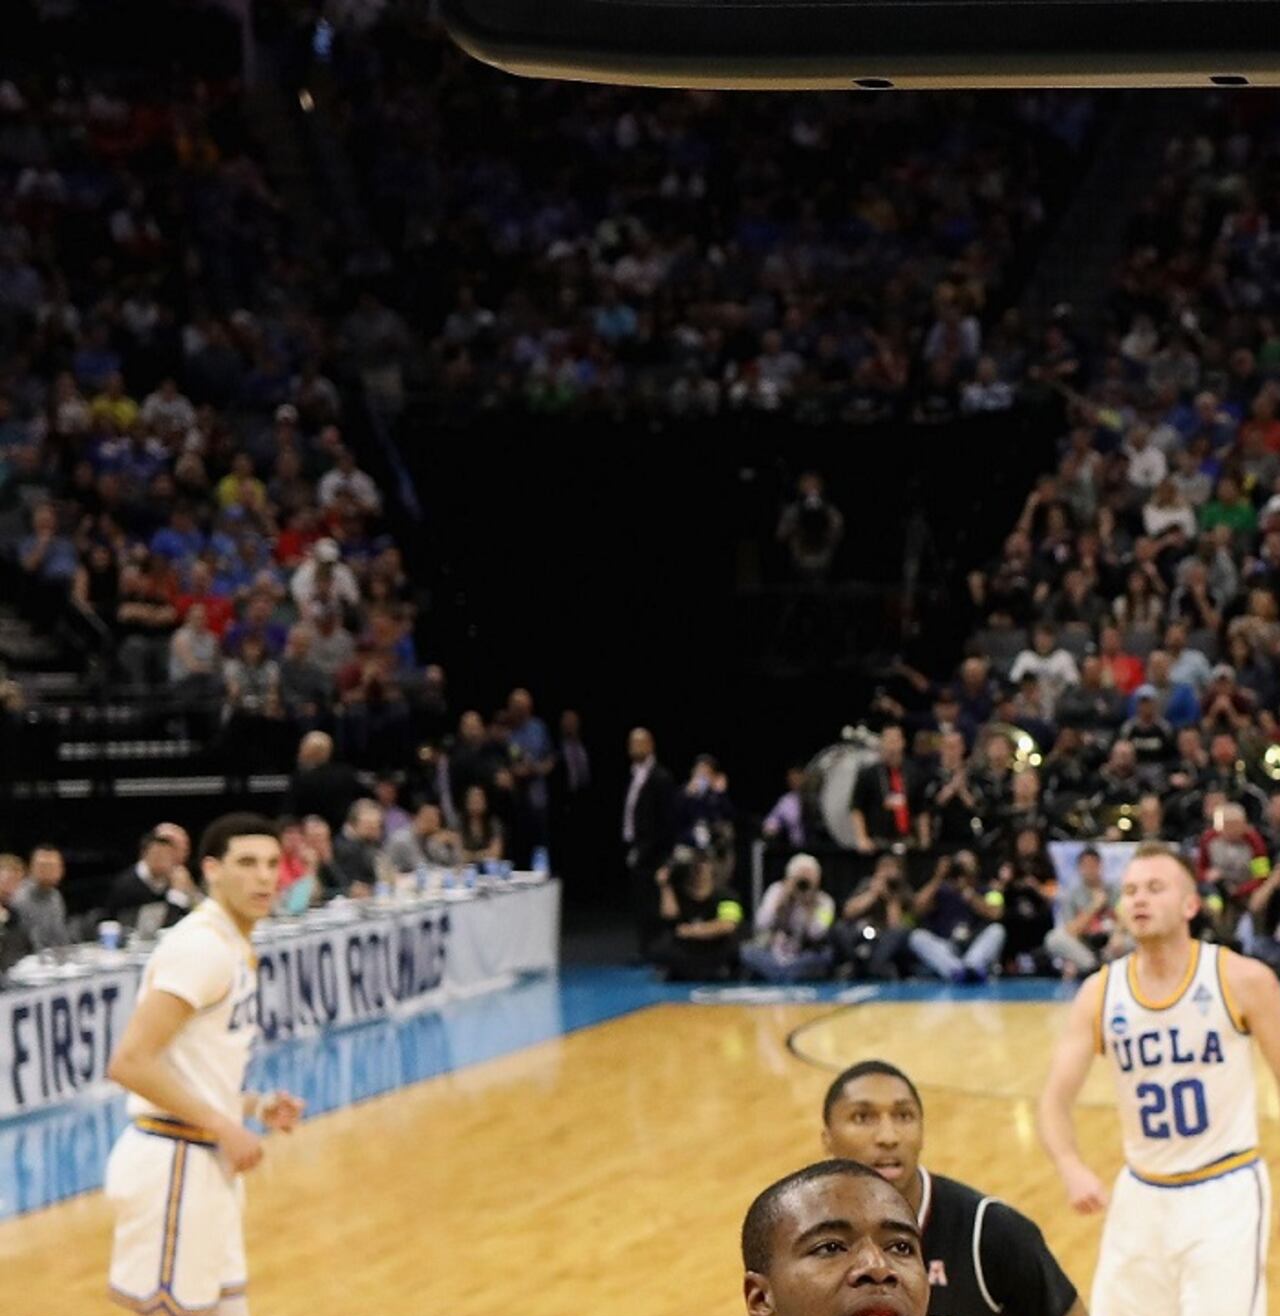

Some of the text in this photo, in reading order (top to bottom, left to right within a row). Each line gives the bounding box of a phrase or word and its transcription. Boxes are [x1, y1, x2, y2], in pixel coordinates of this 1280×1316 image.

[12, 985, 119, 1105] FIRST
[1113, 1028, 1224, 1072] UCLA
[1136, 1078, 1210, 1139] 20
